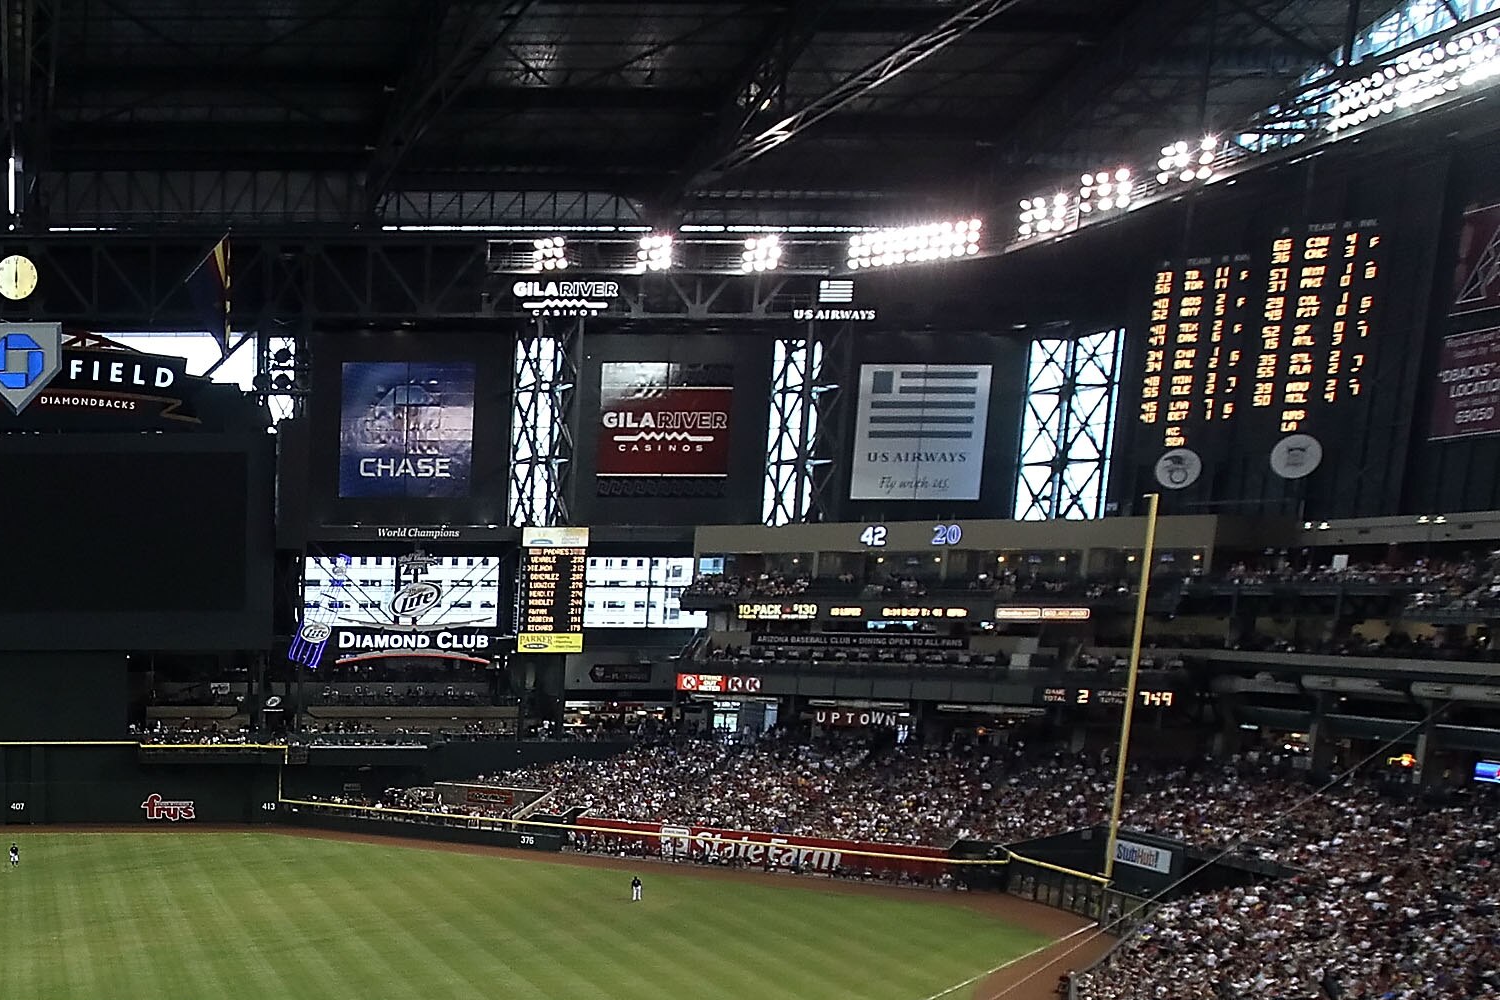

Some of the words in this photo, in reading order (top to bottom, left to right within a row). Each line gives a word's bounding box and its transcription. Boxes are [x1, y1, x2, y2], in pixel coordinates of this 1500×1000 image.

[793, 310, 813, 319] US
[815, 310, 876, 320] AIRWAYS
[70, 359, 174, 388] FIELD
[41, 397, 135, 410] DIAMONDBACKS
[893, 452, 967, 462] AIRWAYS
[360, 458, 451, 477] CHASE
[880, 476, 896, 495] Fly
[900, 476, 929, 488] with
[378, 528, 405, 538] World
[408, 528, 460, 539] Champions
[860, 526, 887, 545] 42
[931, 524, 962, 545] 20
[402, 591, 435, 615] Lite
[738, 604, 781, 615] 10-PACK
[793, 604, 817, 615] $130
[306, 629, 328, 639] Lite
[339, 632, 430, 648] DIAMOND
[437, 631, 489, 648] CLUB
[520, 635, 552, 644] PARKER
[859, 637, 887, 645] DINING
[925, 638, 941, 646] ALL
[1077, 690, 1089, 703] 2
[1140, 691, 1173, 706] 749
[817, 711, 897, 726] UPTOWN
[521, 835, 534, 845] 376
